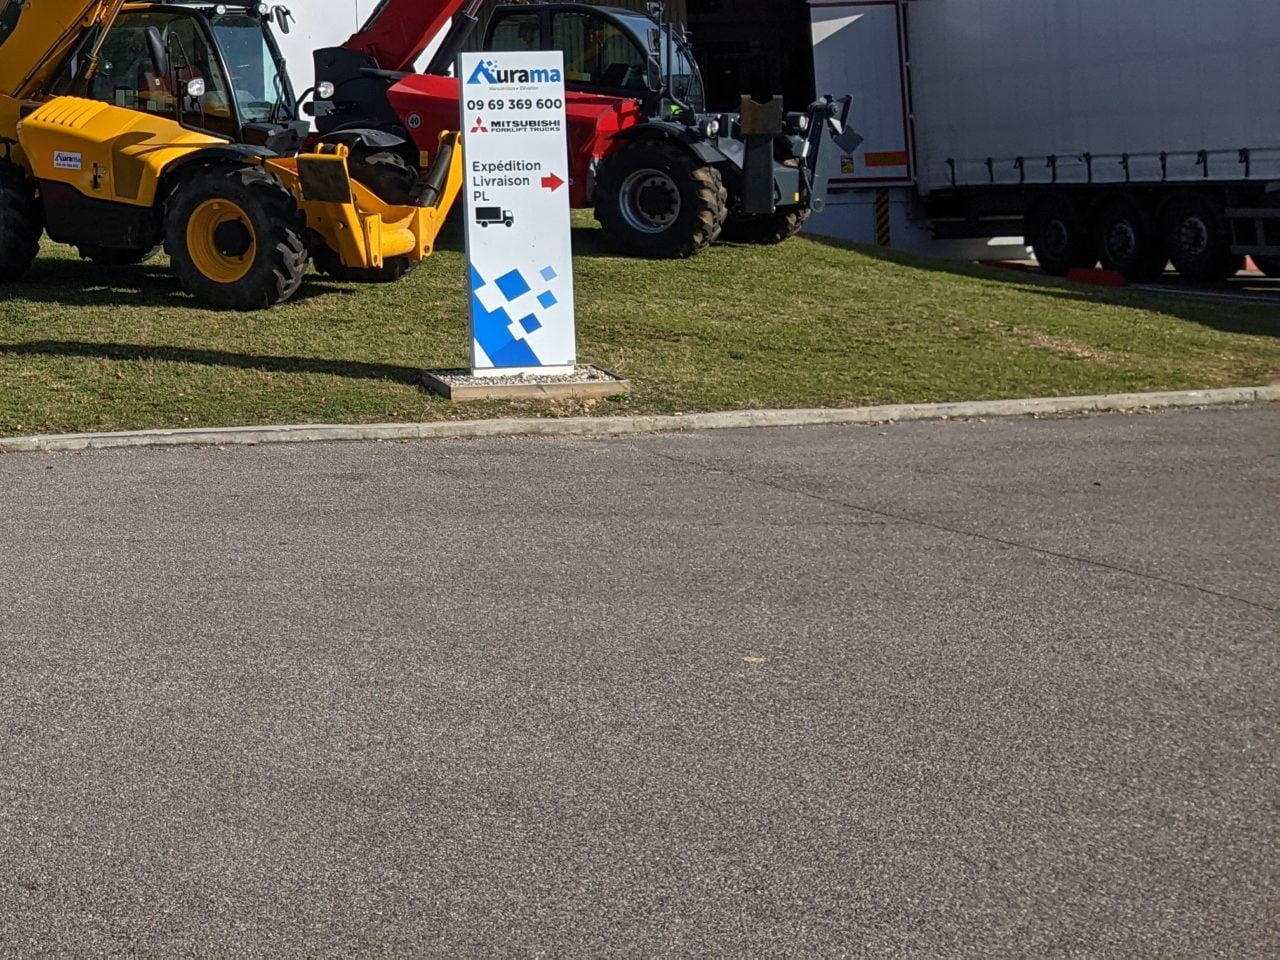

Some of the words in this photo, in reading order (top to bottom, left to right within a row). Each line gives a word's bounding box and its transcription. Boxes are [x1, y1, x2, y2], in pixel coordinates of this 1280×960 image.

[466, 59, 561, 85] Aurama
[467, 100, 484, 110] 09
[488, 100, 504, 110] 69
[508, 99, 532, 110] 369
[536, 98, 562, 109] 600
[410, 117, 419, 125] 40
[491, 120, 560, 128] MITSUBISHI
[472, 160, 542, 174] Expédition
[473, 175, 530, 187] Livraison
[473, 191, 490, 201] PL
